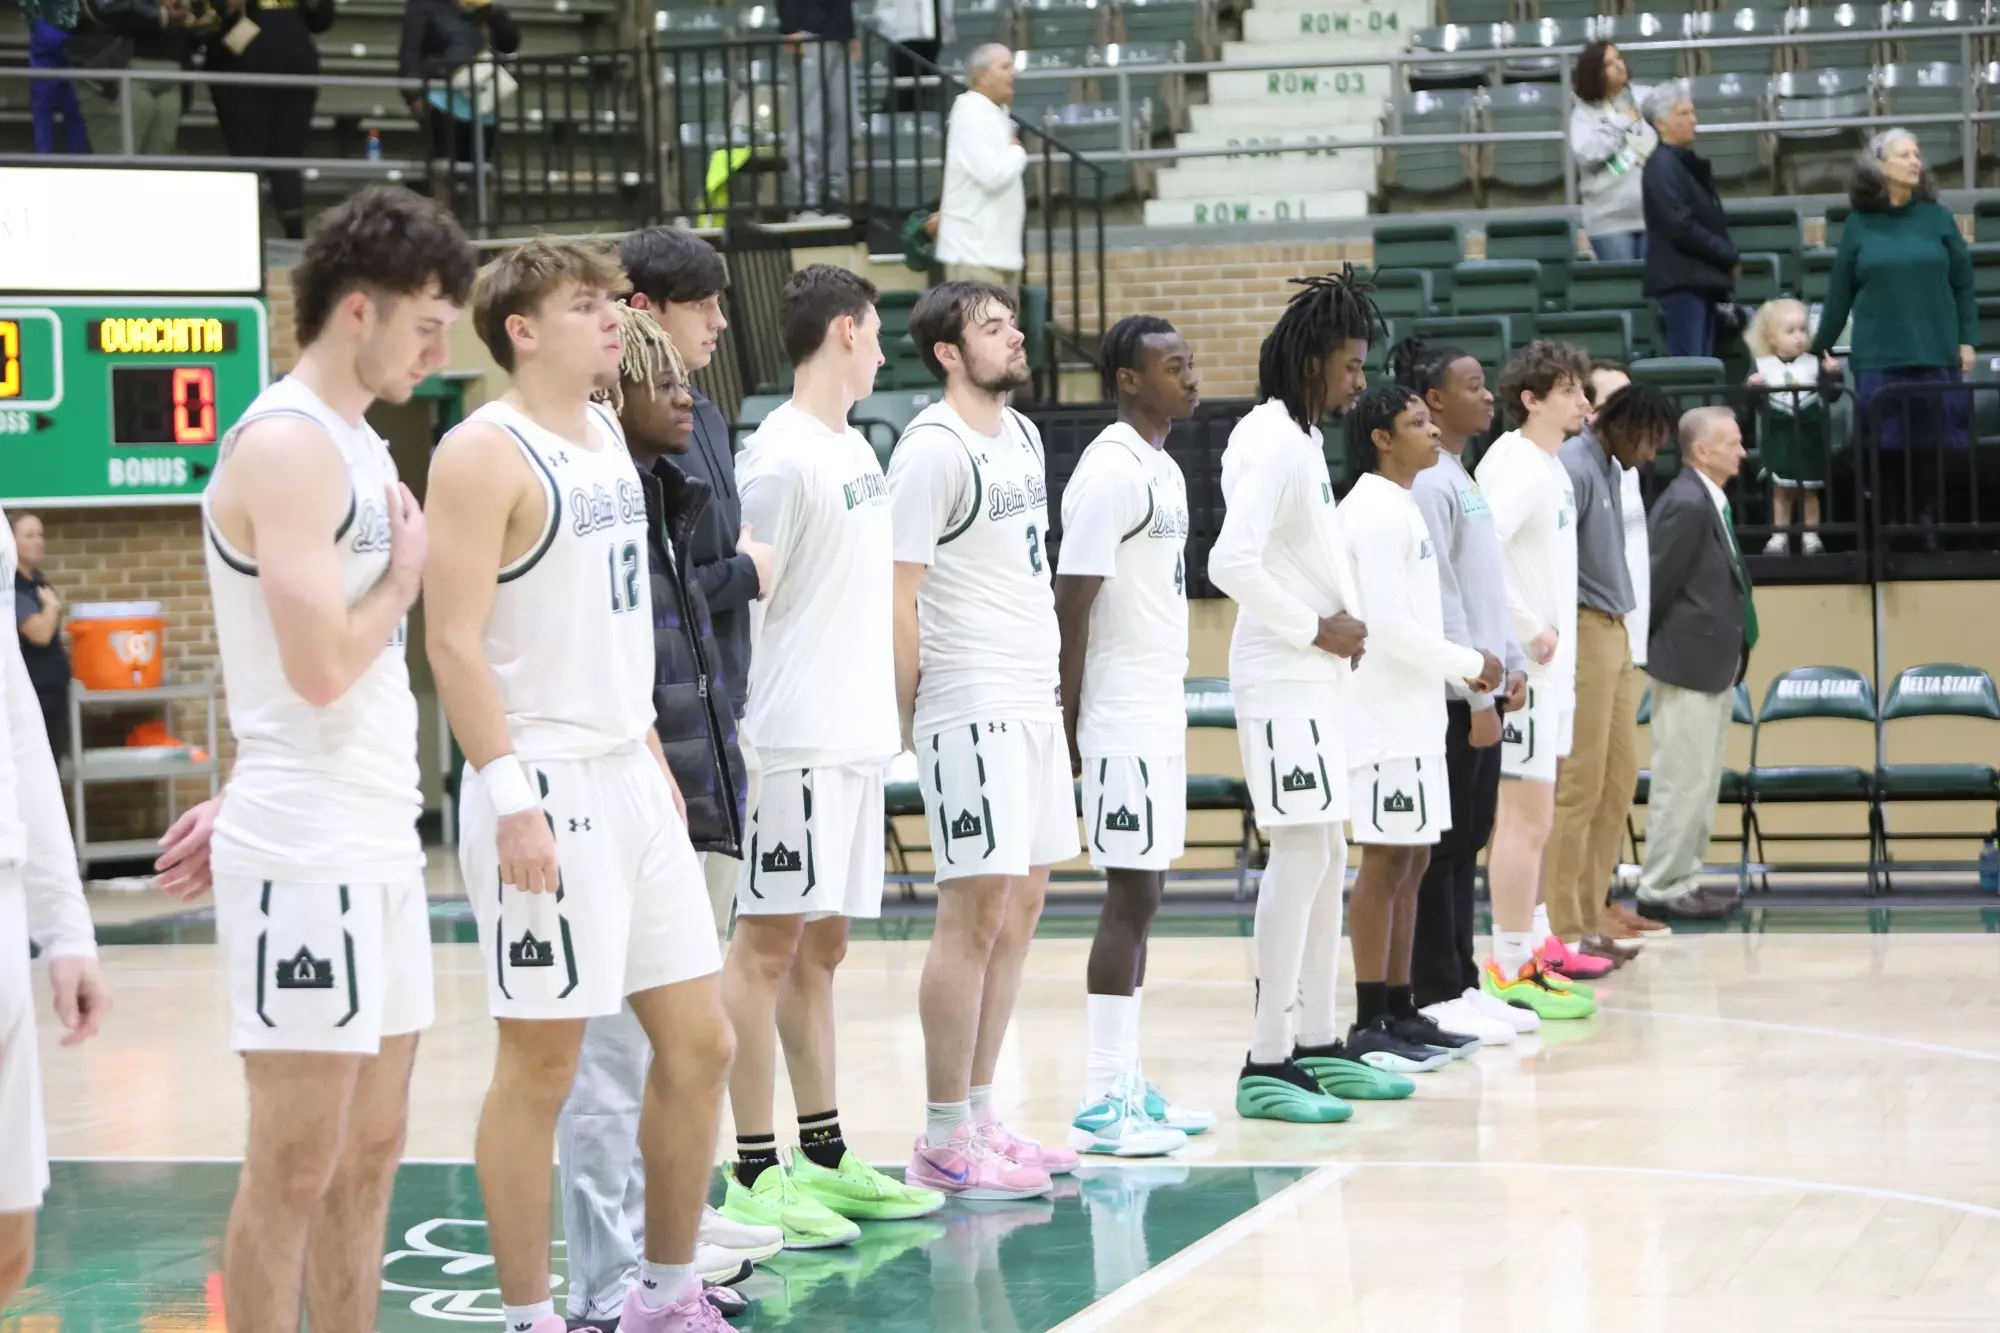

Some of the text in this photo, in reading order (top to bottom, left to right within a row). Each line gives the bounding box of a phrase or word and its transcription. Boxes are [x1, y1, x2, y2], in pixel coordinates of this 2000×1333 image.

[1301, 11, 1399, 33] ROW-04
[1267, 71, 1365, 94] ROW-03
[1194, 200, 1306, 224] ROW-01
[100, 317, 223, 353] OUACHITA
[172, 367, 216, 443] 0
[108, 457, 188, 487] BONUS
[988, 481, 1027, 521] Delta
[1026, 523, 1043, 577] 2
[608, 539, 640, 614] 12
[1900, 675, 1941, 696] DELTA
